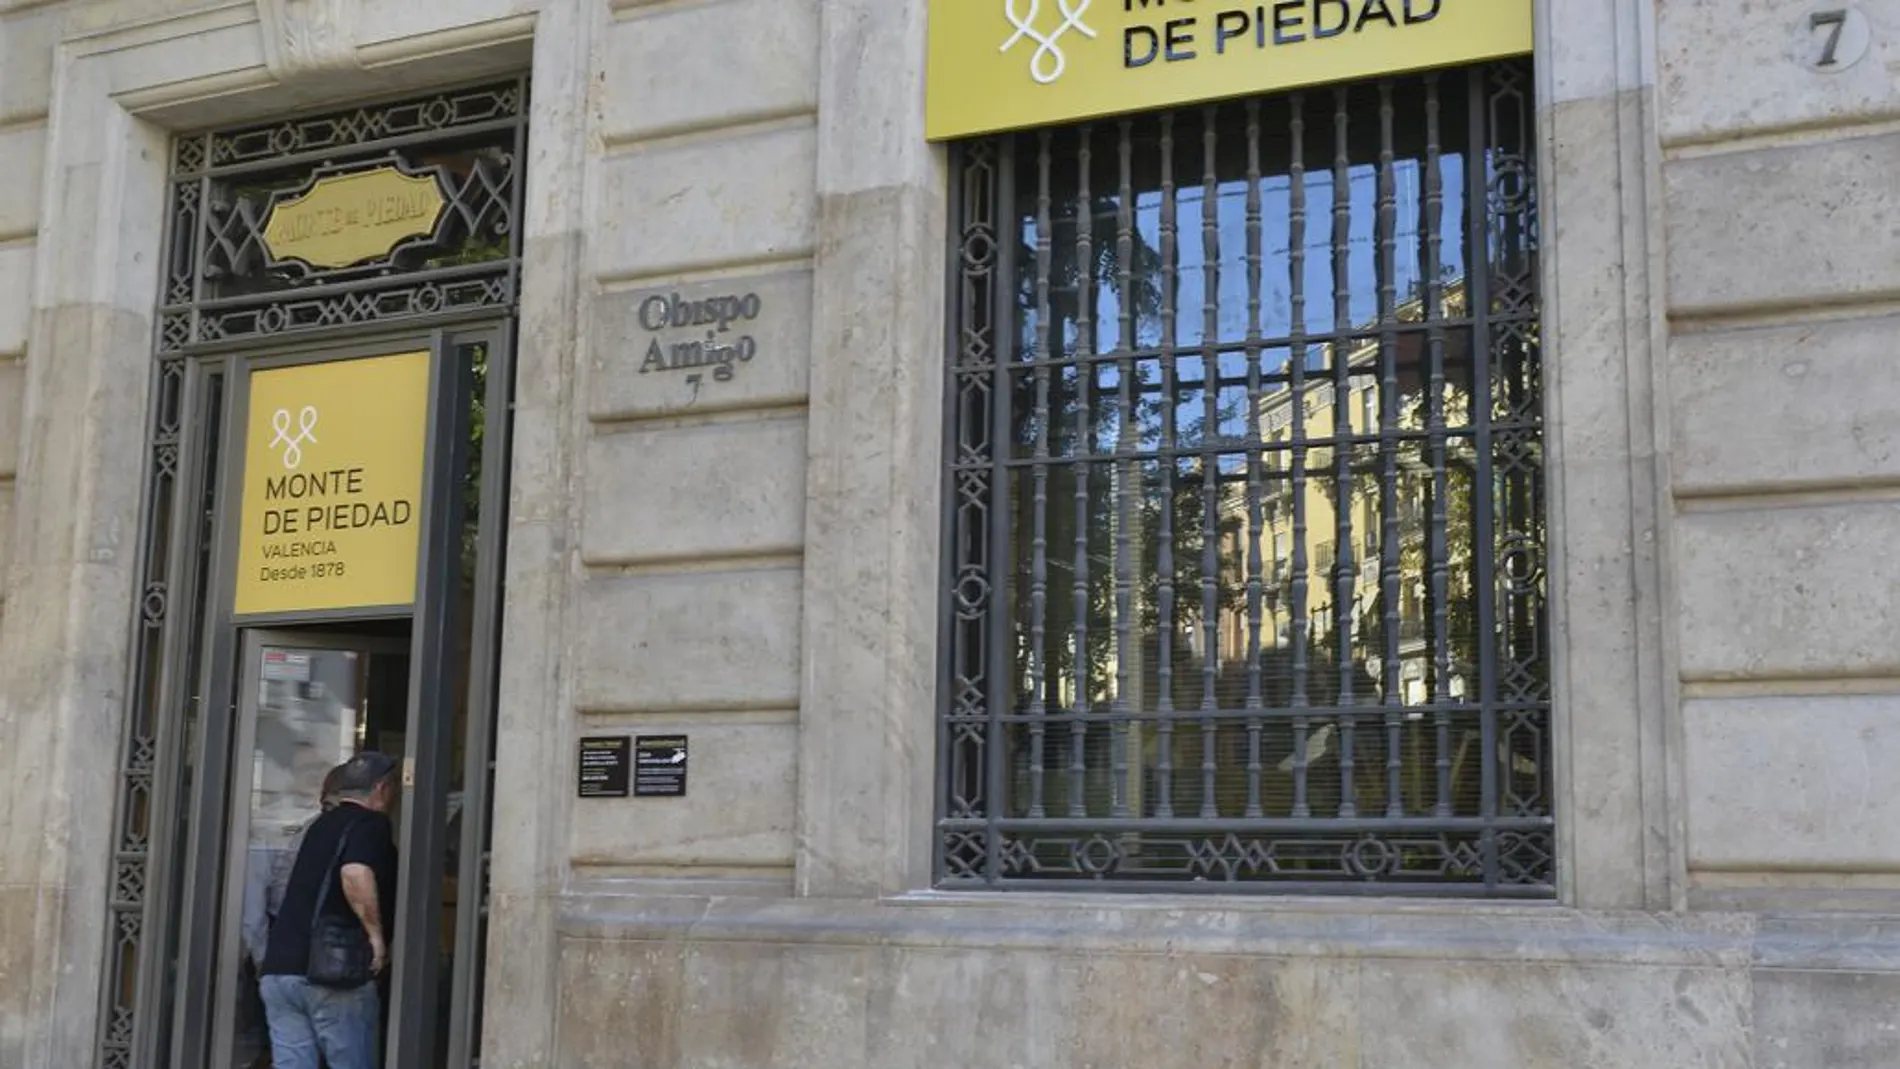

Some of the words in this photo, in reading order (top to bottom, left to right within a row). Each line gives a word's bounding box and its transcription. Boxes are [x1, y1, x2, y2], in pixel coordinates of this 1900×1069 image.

[1124, 17, 1197, 68] DE
[1216, 0, 1441, 54] PIEDAD
[1809, 8, 1847, 66] 7
[639, 292, 761, 332] Obispo
[638, 329, 755, 382] Amigo
[685, 373, 703, 405] 7
[265, 468, 364, 500] MONTE
[263, 508, 299, 535] DE
[306, 500, 411, 532] PIEDAD
[262, 540, 337, 559] VALENCIA
[260, 565, 307, 582] Desde
[310, 562, 346, 579] 1878
